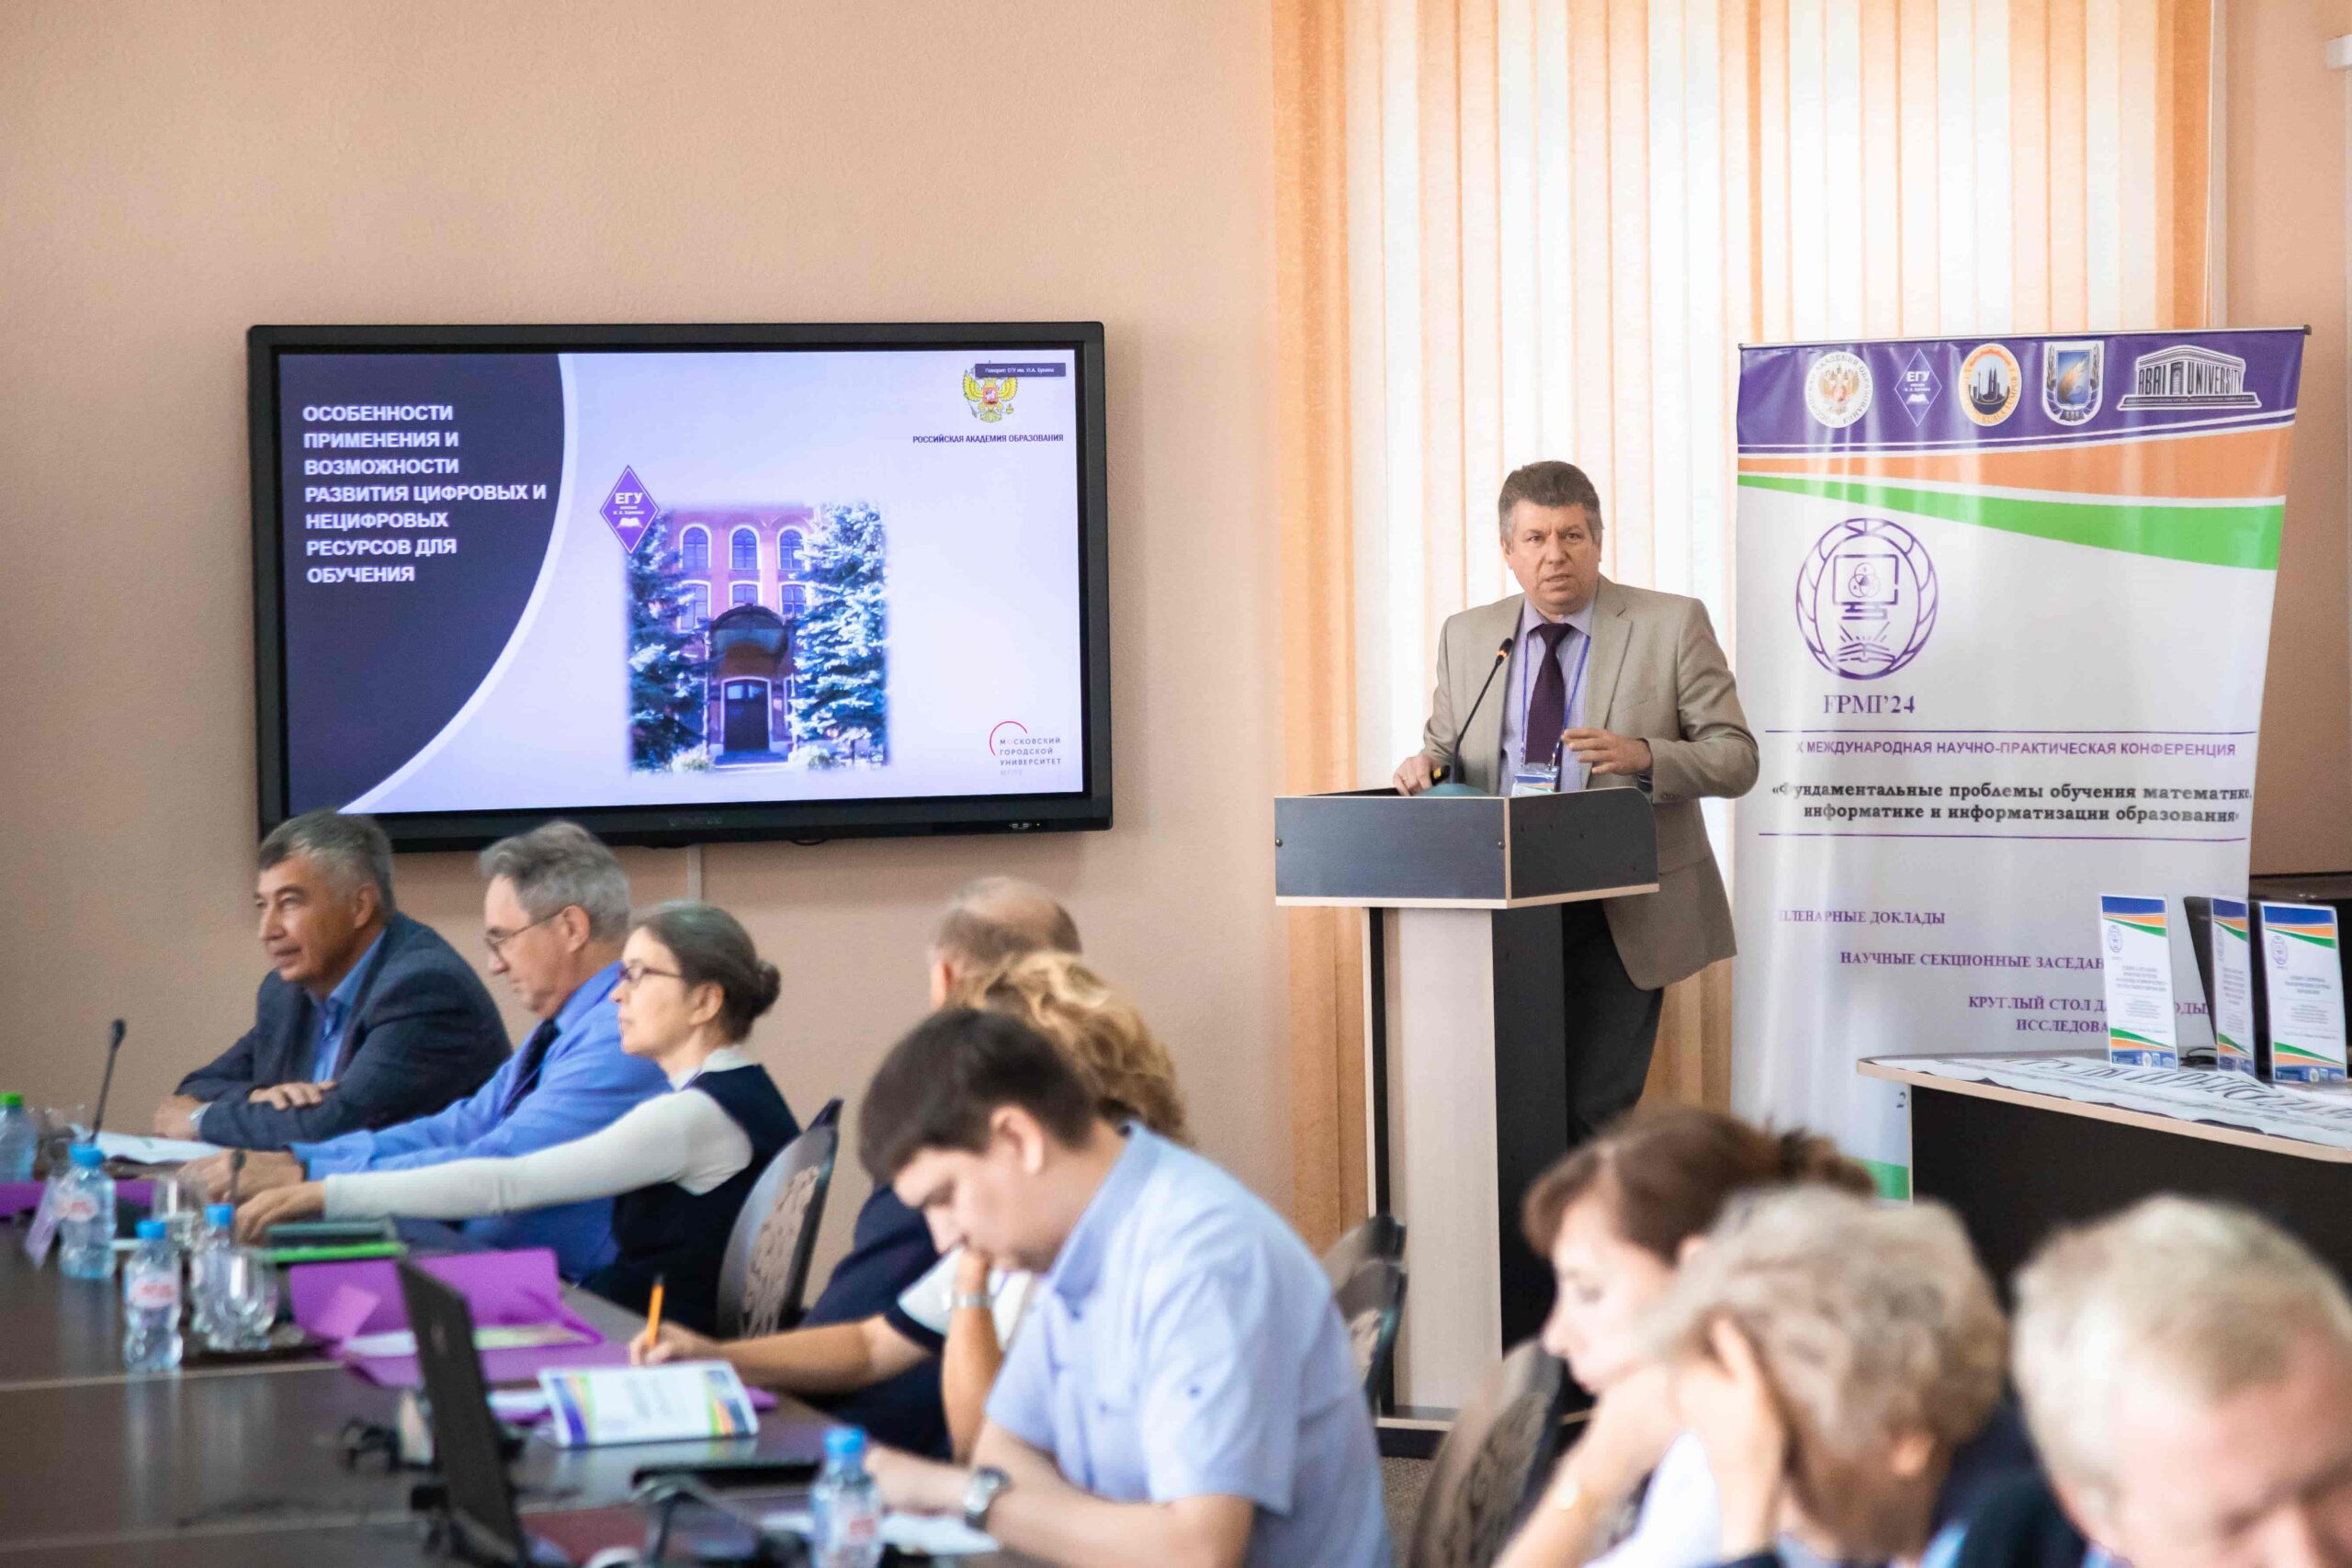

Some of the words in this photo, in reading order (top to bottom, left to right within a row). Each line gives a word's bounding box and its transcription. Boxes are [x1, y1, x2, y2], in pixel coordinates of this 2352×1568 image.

[1906, 371, 1930, 382] ЕГУ
[2139, 365, 2166, 395] ABAI
[2188, 361, 2242, 395] UNIVERSITY
[302, 405, 453, 423] ОСОБЕННОСТИ
[303, 432, 440, 449] ПРИМЕНЕНИЯ
[446, 432, 458, 447] И
[912, 434, 964, 444] РОССИЙСКАЯ
[966, 434, 1007, 444] АКАДЕМИЯ
[1009, 434, 1064, 443] ОБРАЗОВАНИЯ
[304, 458, 458, 476] ВОЗМОЖНОСТИ
[305, 485, 409, 502] РАЗВИТИЯ
[413, 484, 528, 504] ЦИФРОВЫХ
[533, 484, 547, 501] И
[616, 492, 643, 504] ЕГУ
[306, 512, 448, 531] НЕЦИФРОВЫХ
[306, 539, 412, 557] РЕСУРСОВ
[415, 538, 457, 558] ДЛЯ
[307, 566, 415, 583] ОБУЧЕНИЯ
[1000, 737, 1061, 745] МОСКОВСКИЙ
[1807, 741, 1932, 756] МЕЖДУНАРОДНАЯ
[1937, 741, 2117, 755] НАУЧНО-ПРАКТИЧЕСКАЯ
[2120, 743, 2235, 758] КОНФЕРЕНЦИЯ
[1000, 748, 1053, 756] ГОРОДСКОЙ
[1000, 758, 1061, 766] УНИВЕРСИТЕТ
[1950, 783, 2044, 801] проблемы
[2050, 784, 2136, 802] обучения
[1804, 803, 1924, 821] информатике
[1930, 807, 1941, 818] и
[1948, 805, 2109, 821] информатизации
[1870, 911, 1946, 925] ДОКЛАДЫ
[1840, 952, 1916, 964] НАУЧНЫЕ
[1920, 953, 2030, 967] СЕКЦИОННЫЕ
[2036, 957, 2104, 970] ЗАСЕДАН
[1968, 995, 2044, 1010] КРУГЛЫЙ
[2049, 999, 2090, 1011] СТОЛ
[2016, 1019, 2109, 1033] ИССЛЕДОВА
